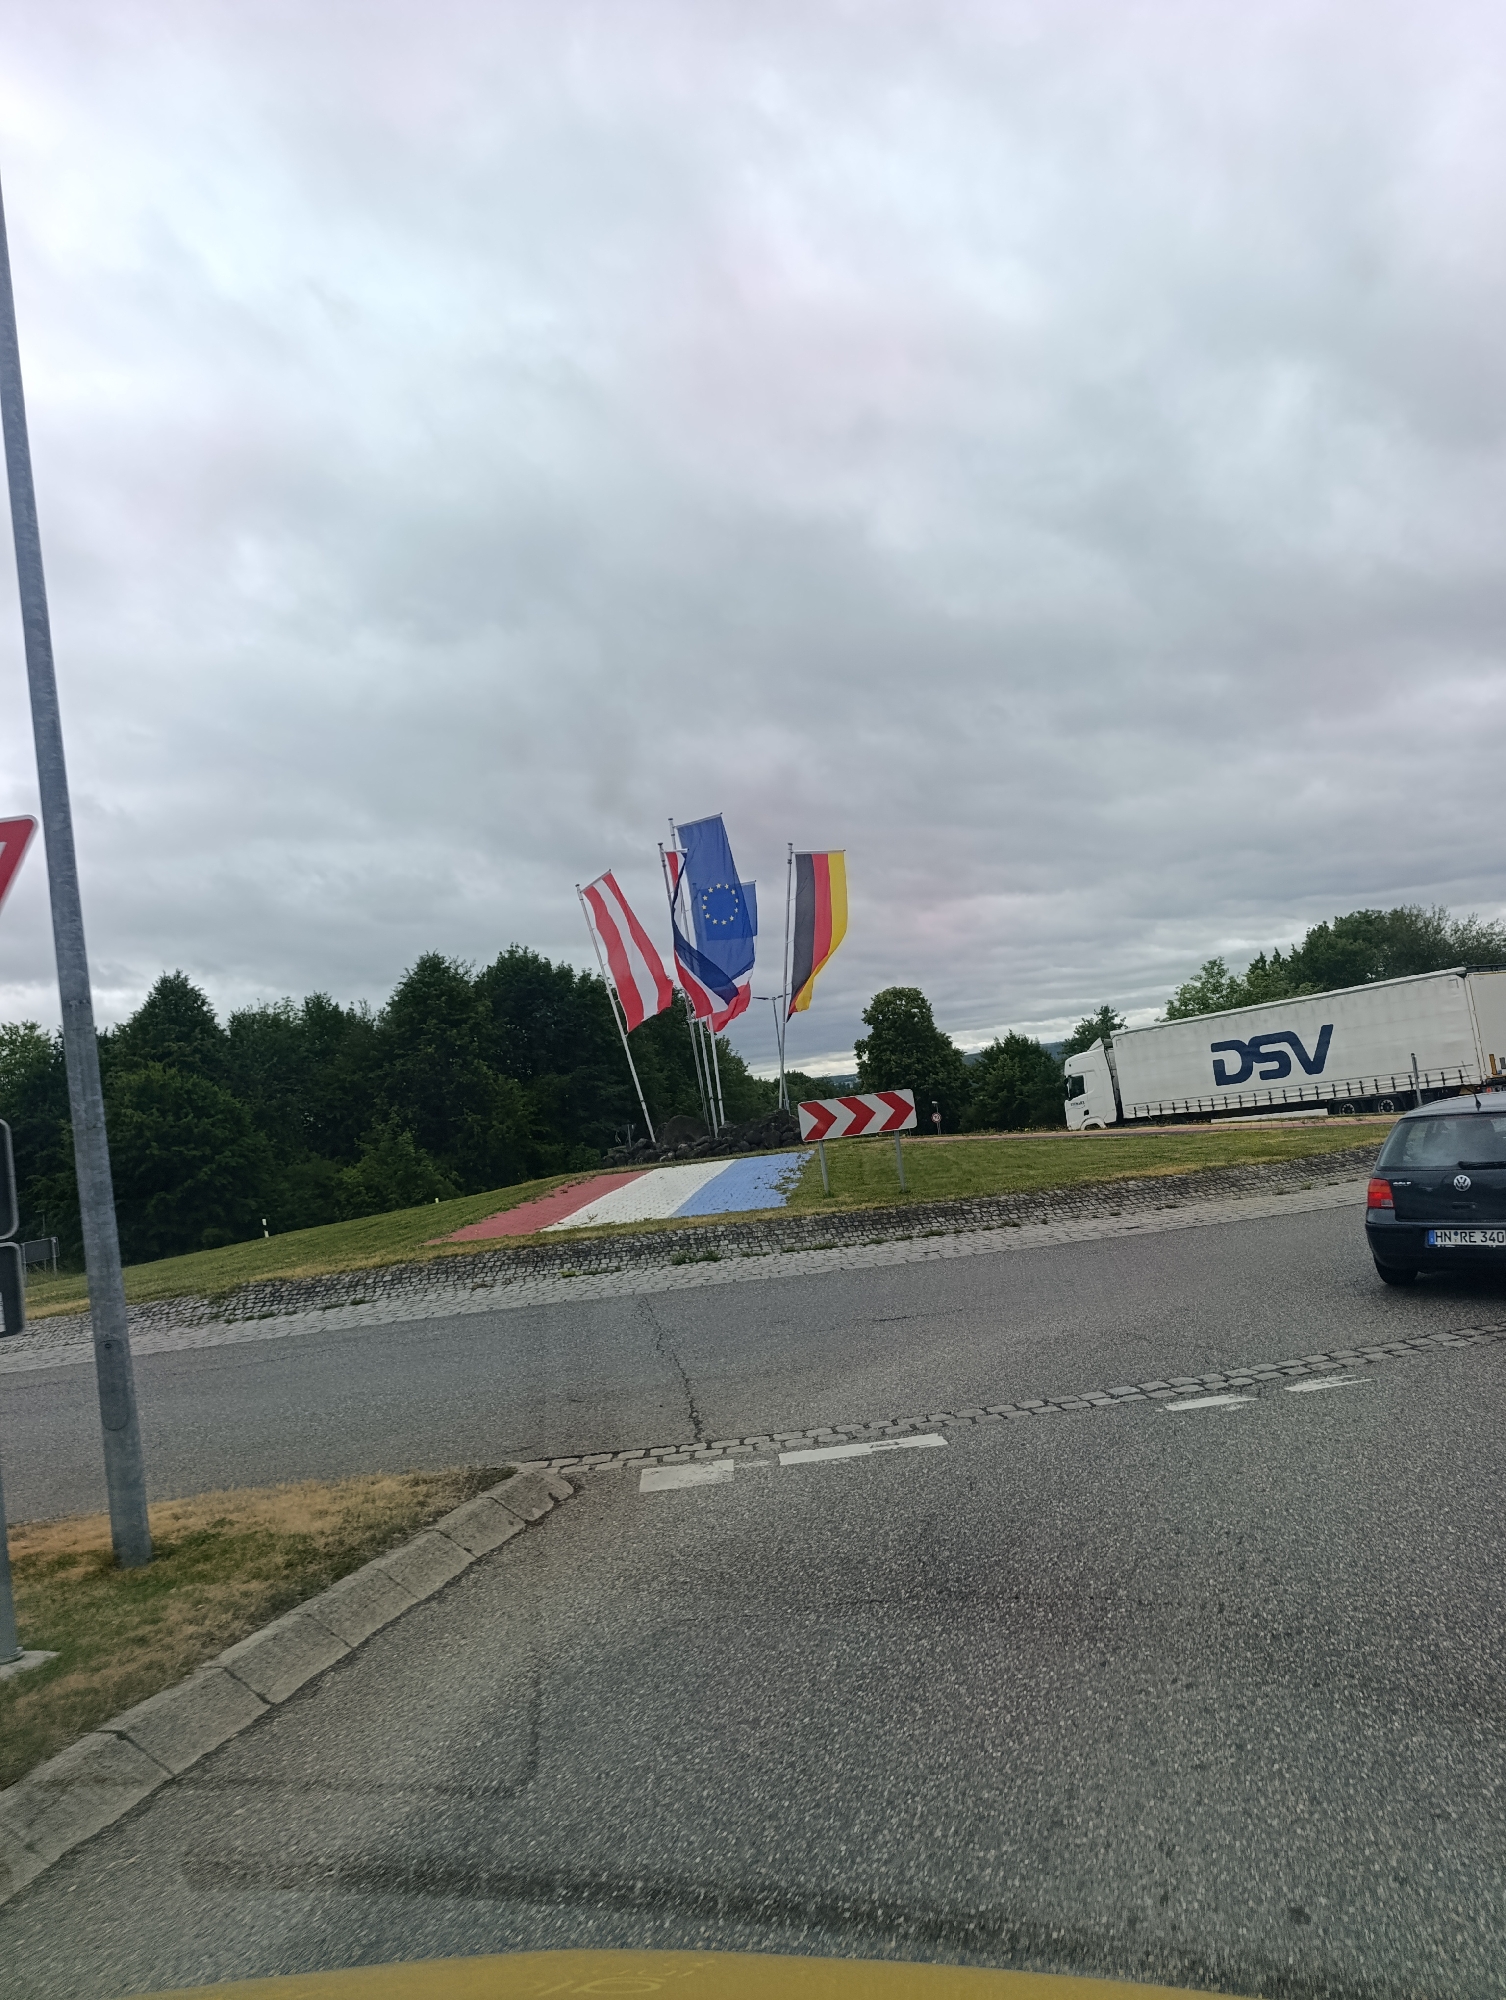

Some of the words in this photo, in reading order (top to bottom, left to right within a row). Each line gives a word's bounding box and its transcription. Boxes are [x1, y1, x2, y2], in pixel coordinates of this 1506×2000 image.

[1210, 1024, 1334, 1087] DSV
[1435, 1231, 1452, 1243] HN
[1460, 1231, 1477, 1243] RE
[1480, 1231, 1505, 1243] 340
